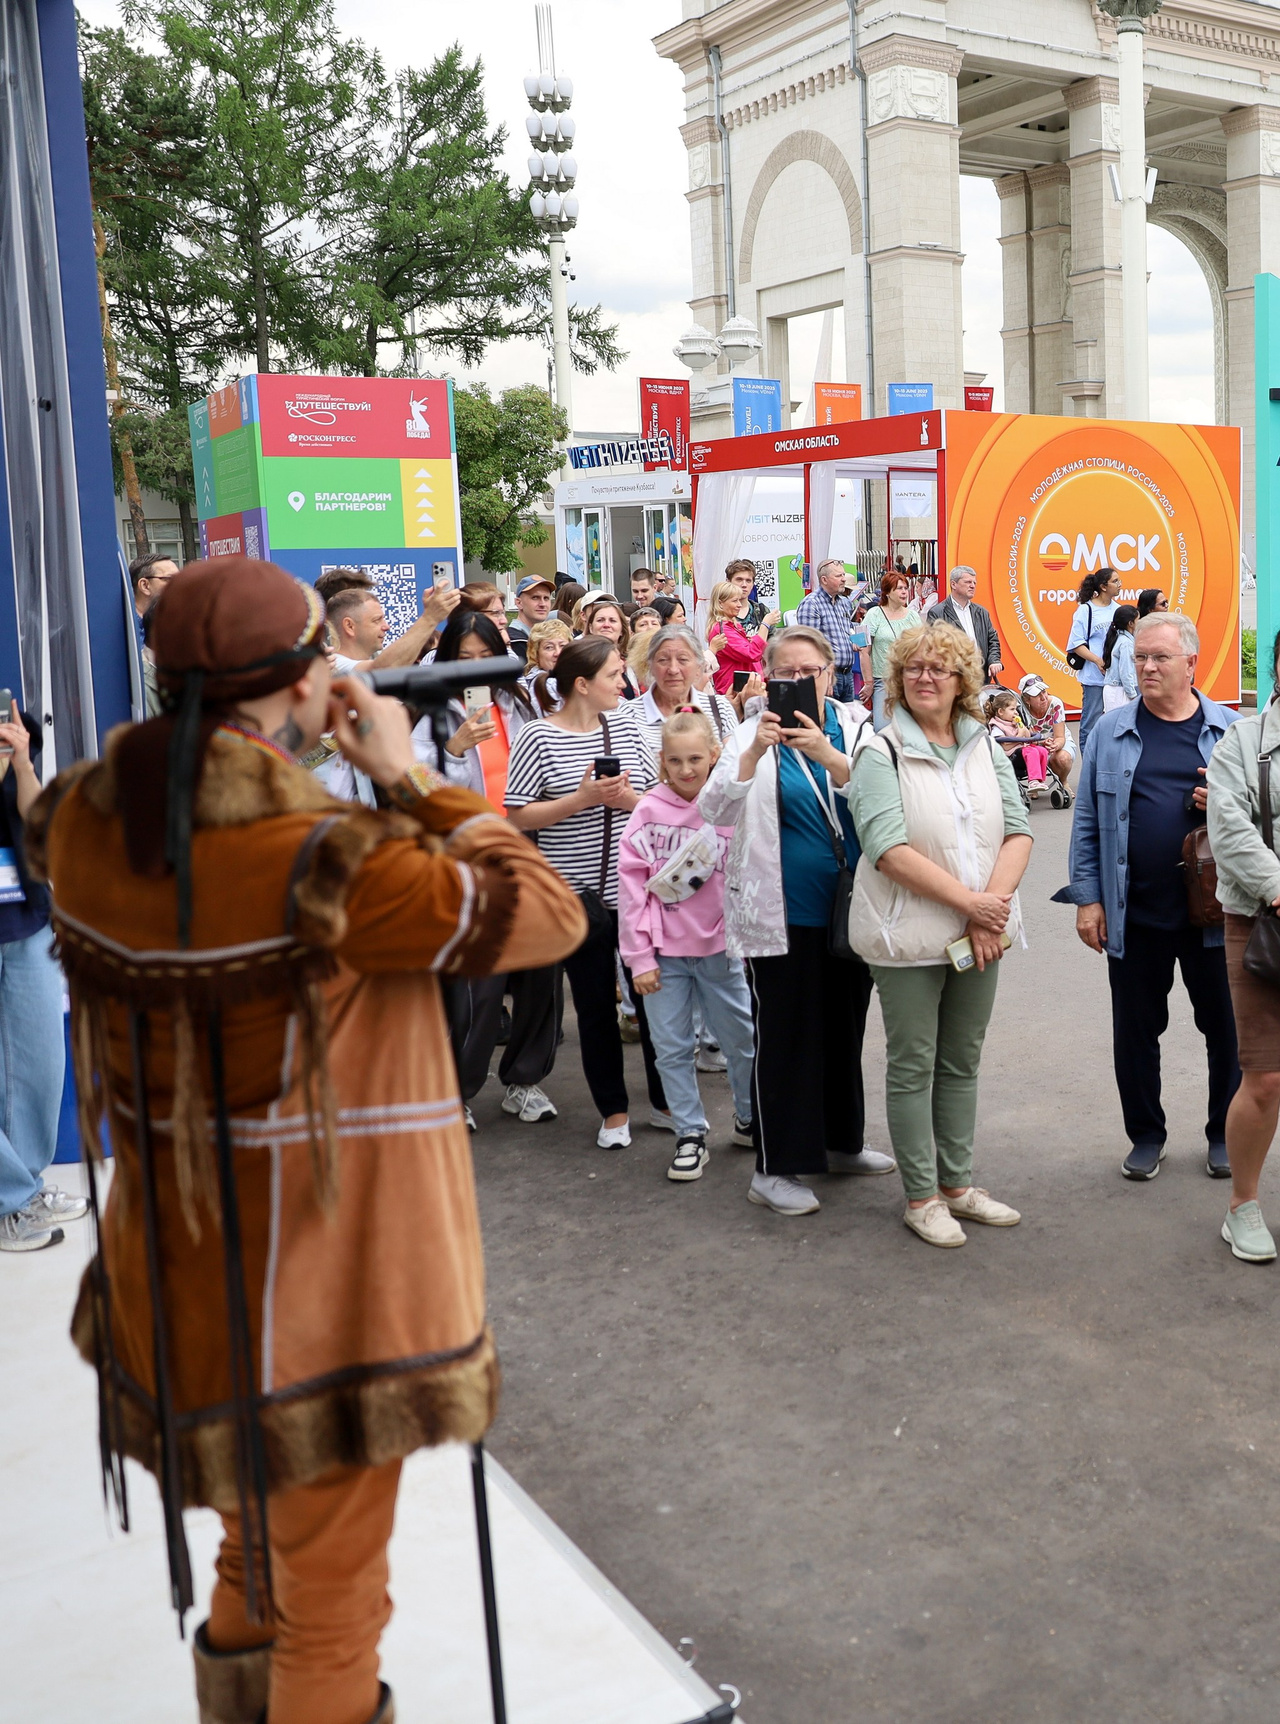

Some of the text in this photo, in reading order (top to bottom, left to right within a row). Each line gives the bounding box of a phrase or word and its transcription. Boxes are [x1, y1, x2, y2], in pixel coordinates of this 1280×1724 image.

[296, 401, 371, 411] ПУТЕШЕСТВУЙ!
[775, 434, 839, 452] ОМСКАЯ ОБЛАСТЬ
[1029, 459, 1084, 504] МОЛОДЁЖНАЯ
[1085, 457, 1126, 472] СТОЛИЦА
[314, 492, 392, 501] БЛАГОДАРИМ
[315, 502, 386, 511] ПАРТНЕРОВ!
[209, 536, 241, 557] ПУТЕШЕСТВИЯ
[1038, 532, 1161, 572] ОМСК
[1176, 532, 1190, 605] МОЛОДЁЖНАЯ
[1038, 589, 1078, 606] горо
[1012, 595, 1036, 643] СТОЛИЦА
[1034, 642, 1079, 678] ЛОДЁЖНАЯ
